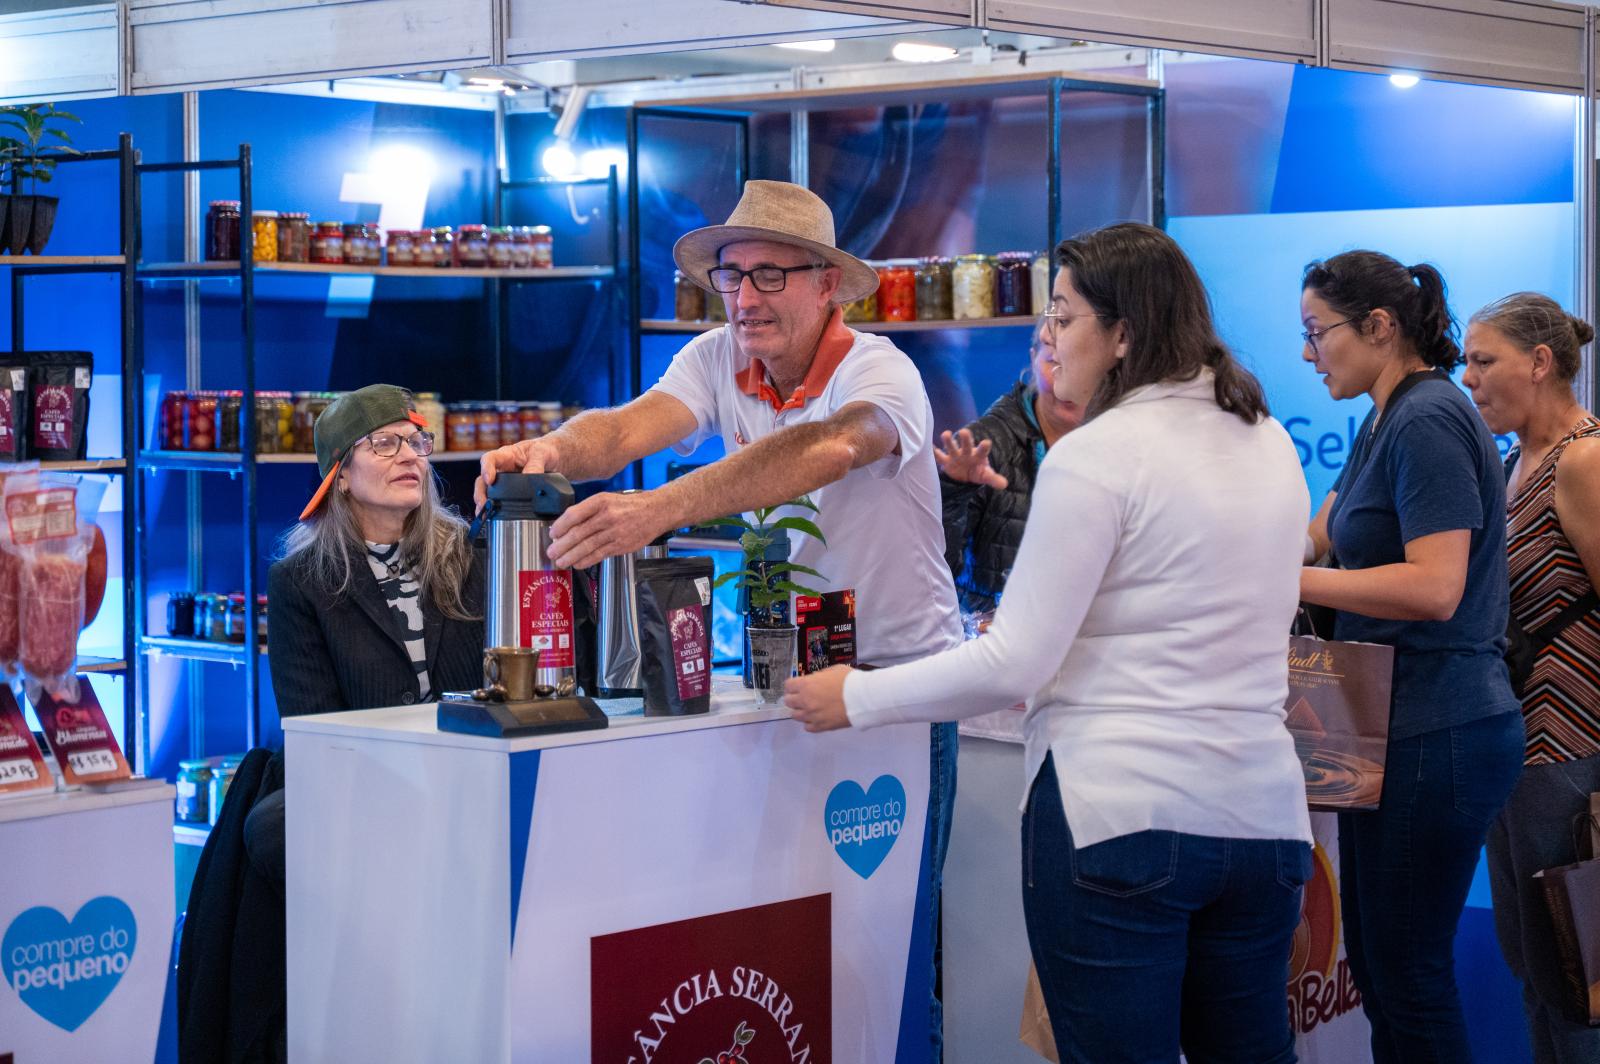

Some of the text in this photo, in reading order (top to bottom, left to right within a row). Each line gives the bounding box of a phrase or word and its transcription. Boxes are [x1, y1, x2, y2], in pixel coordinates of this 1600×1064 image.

[1284, 416, 1355, 470] Sel
[523, 576, 554, 608] ESTÂNCIA
[532, 619, 569, 628] ESPECIAIS
[540, 611, 564, 620] CAFÉS
[838, 624, 852, 632] LUGAR
[831, 797, 901, 827] compre do
[832, 819, 901, 849] pequeno
[12, 924, 128, 968] compre do
[13, 952, 129, 996] pequeno
[627, 969, 723, 1064] ÂNCIA
